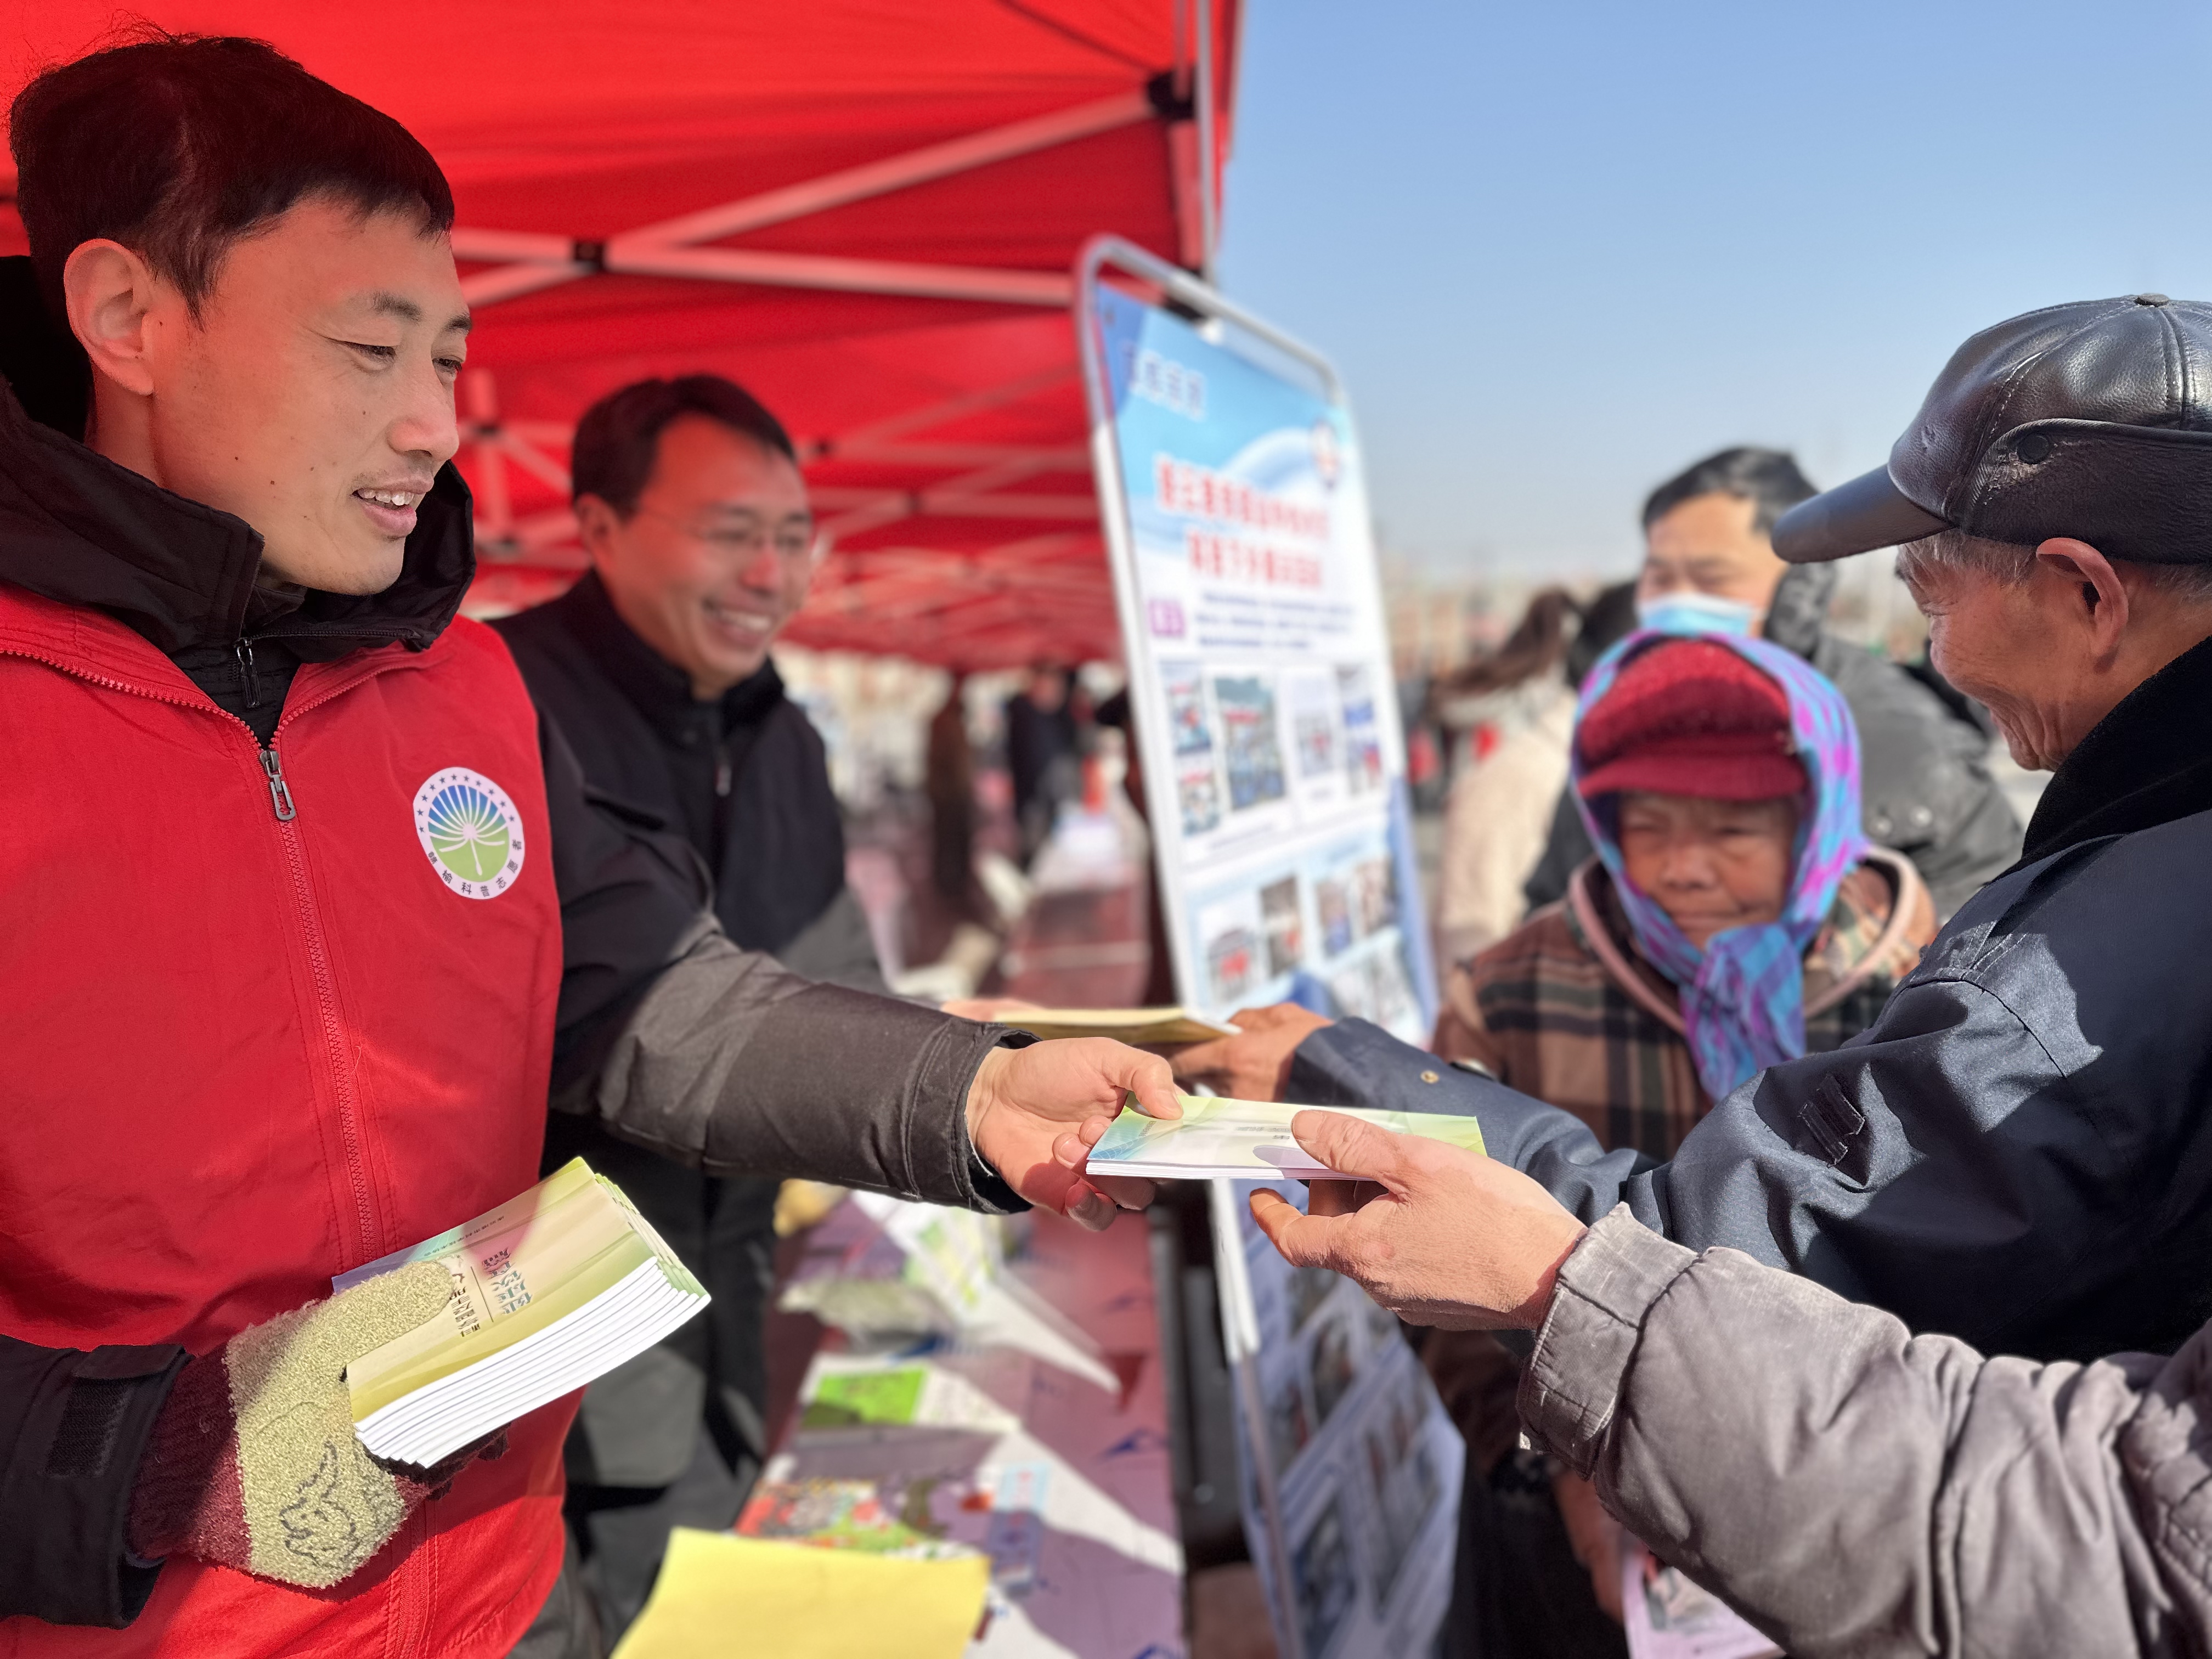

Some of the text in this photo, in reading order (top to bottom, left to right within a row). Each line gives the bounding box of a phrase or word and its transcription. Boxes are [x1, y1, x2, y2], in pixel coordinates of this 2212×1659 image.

[483, 1248, 533, 1315] 健康饮食篇
